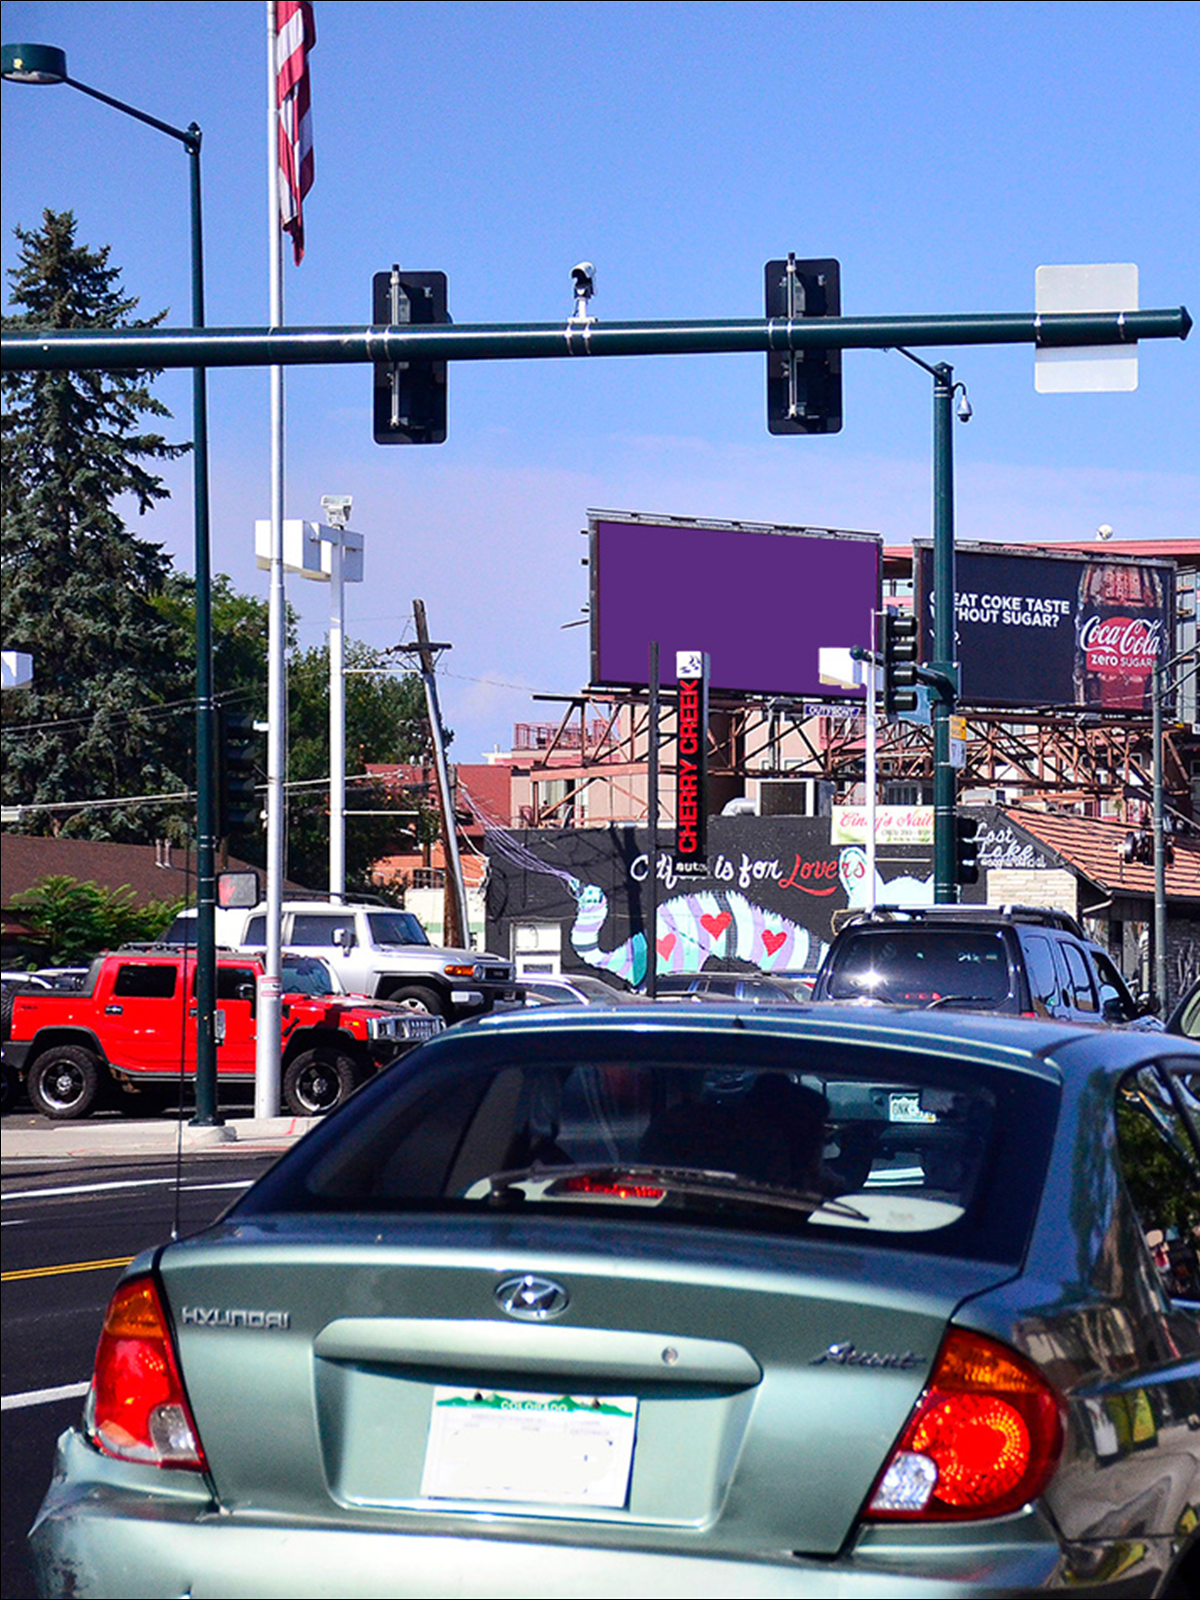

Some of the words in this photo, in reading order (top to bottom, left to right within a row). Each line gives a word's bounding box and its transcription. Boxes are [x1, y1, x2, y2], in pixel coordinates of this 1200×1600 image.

[929, 591, 978, 607] EAT
[981, 594, 1022, 610] COKE
[1025, 598, 1070, 614] TASTE
[1002, 611, 1059, 628] SUGAR?
[1091, 654, 1119, 667] zero
[679, 679, 699, 754] CREEK
[679, 758, 698, 853] CHERRY
[840, 811, 893, 833] Ciny's
[714, 854, 734, 880] is
[739, 853, 783, 888] for
[778, 854, 865, 897] Lovers
[181, 1306, 291, 1329] HYUNDAI
[500, 1400, 569, 1412] COLORADO
